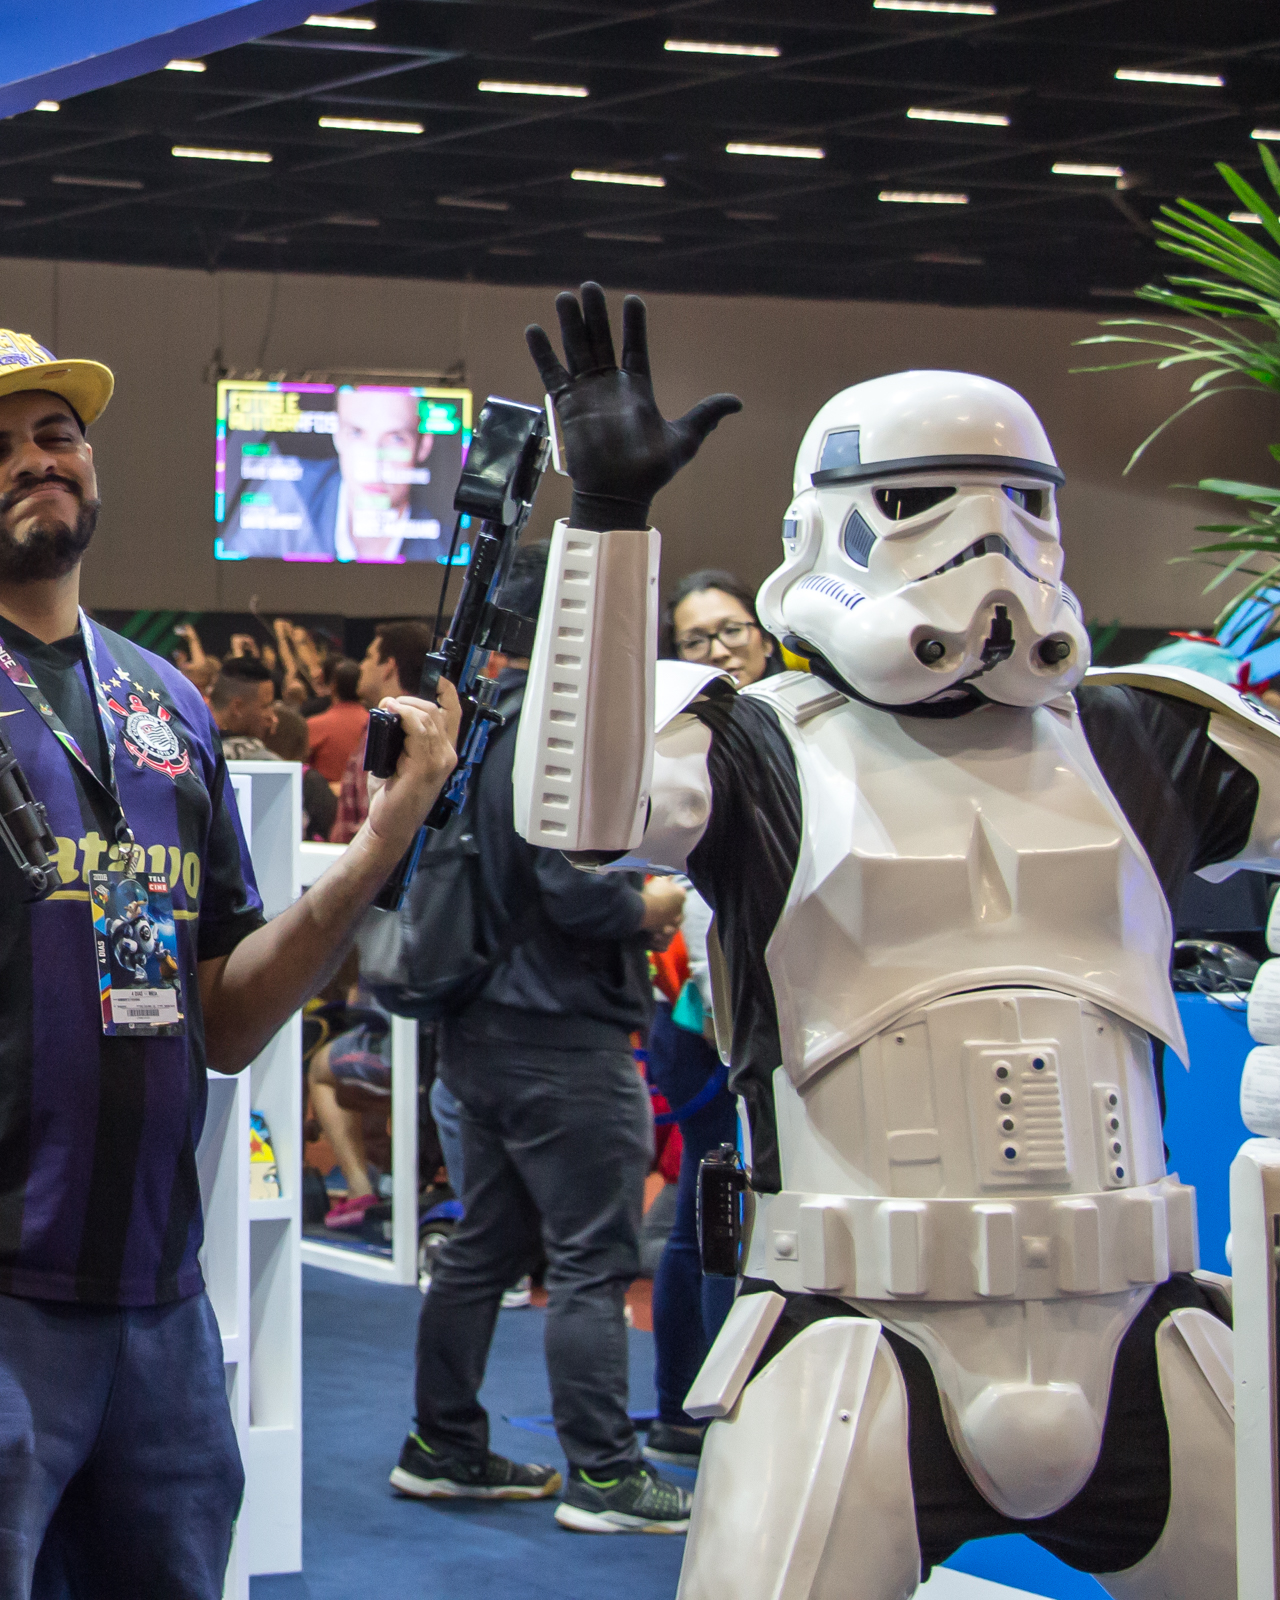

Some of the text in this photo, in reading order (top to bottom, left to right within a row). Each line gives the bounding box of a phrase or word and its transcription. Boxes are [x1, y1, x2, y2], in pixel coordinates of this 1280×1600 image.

[148, 875, 166, 883] TELE
[148, 884, 167, 892] CINE
[97, 940, 106, 957] DIAS
